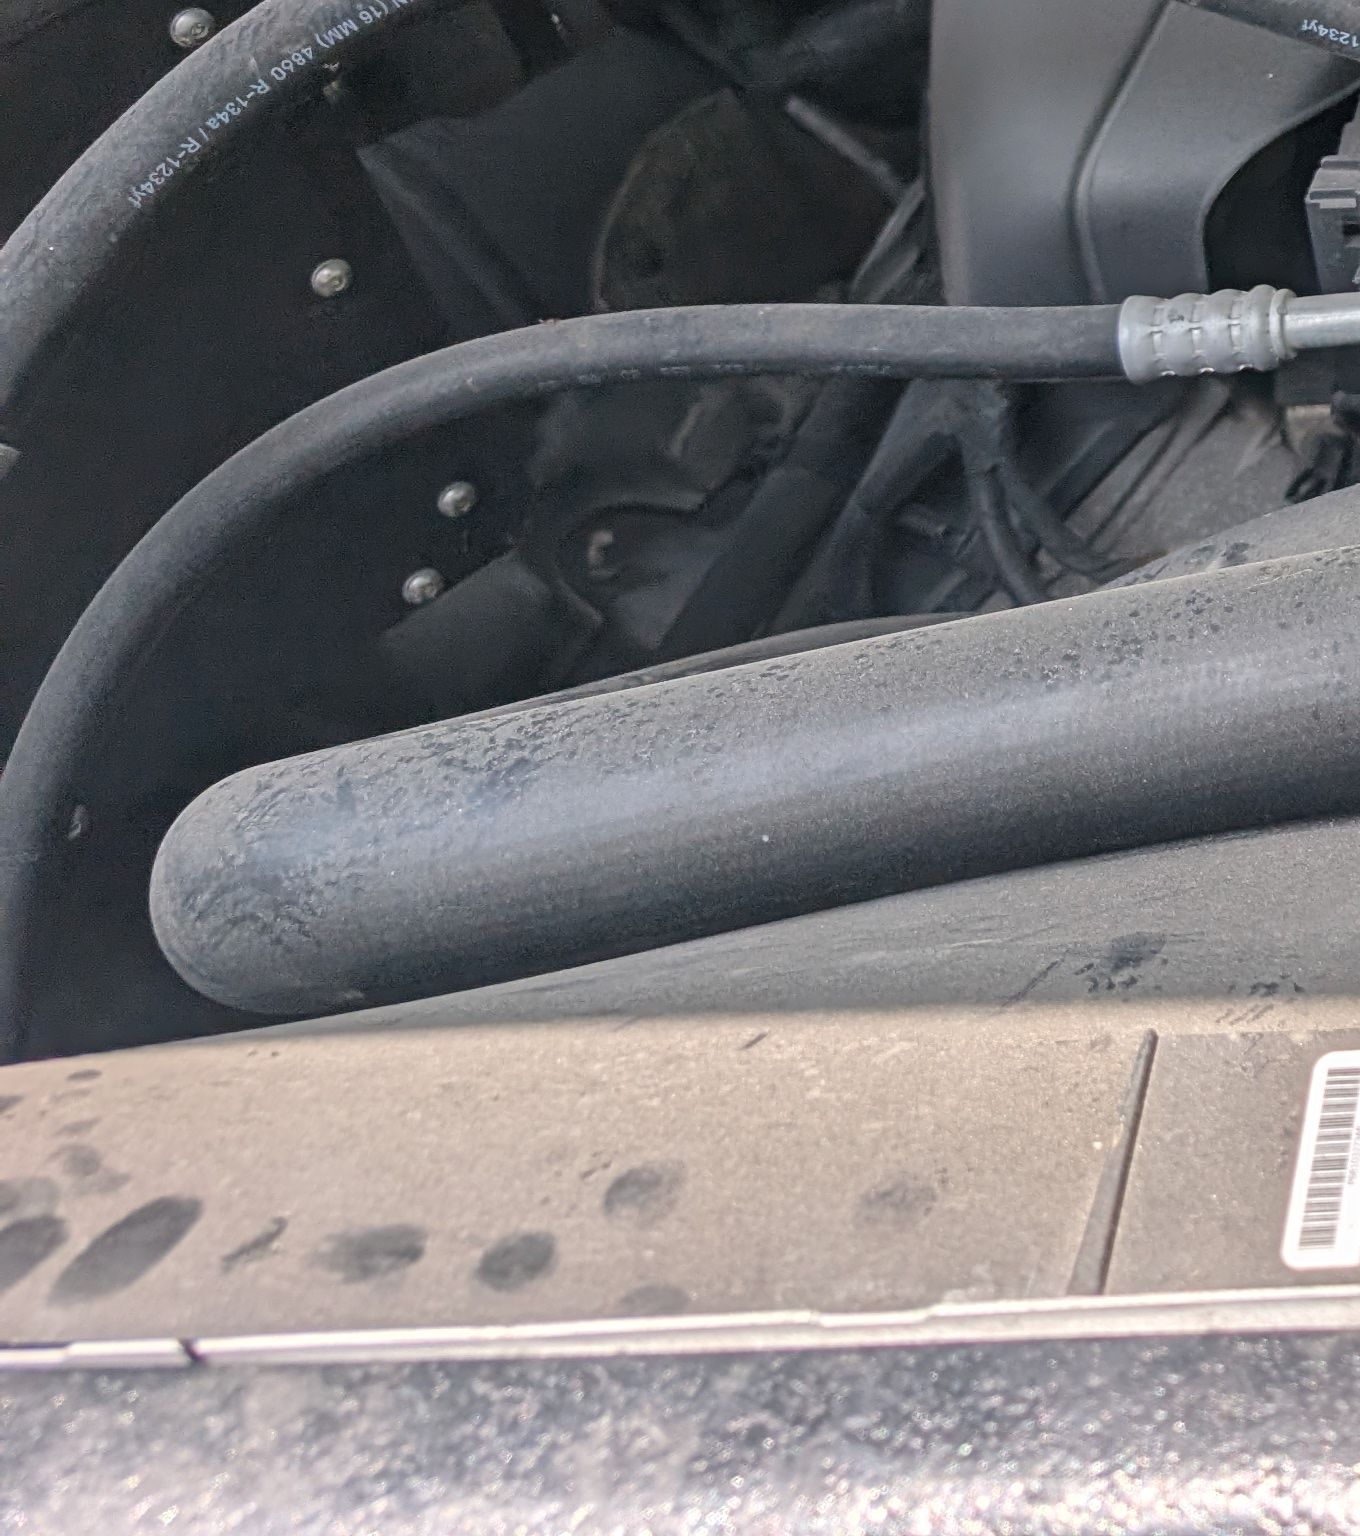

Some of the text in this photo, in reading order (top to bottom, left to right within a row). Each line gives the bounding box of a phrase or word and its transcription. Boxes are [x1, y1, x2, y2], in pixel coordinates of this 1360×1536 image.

[315, 10, 358, 49] MM)
[270, 44, 315, 82] 4860
[204, 78, 271, 131] R-134a
[126, 137, 203, 209] R-1234yf
